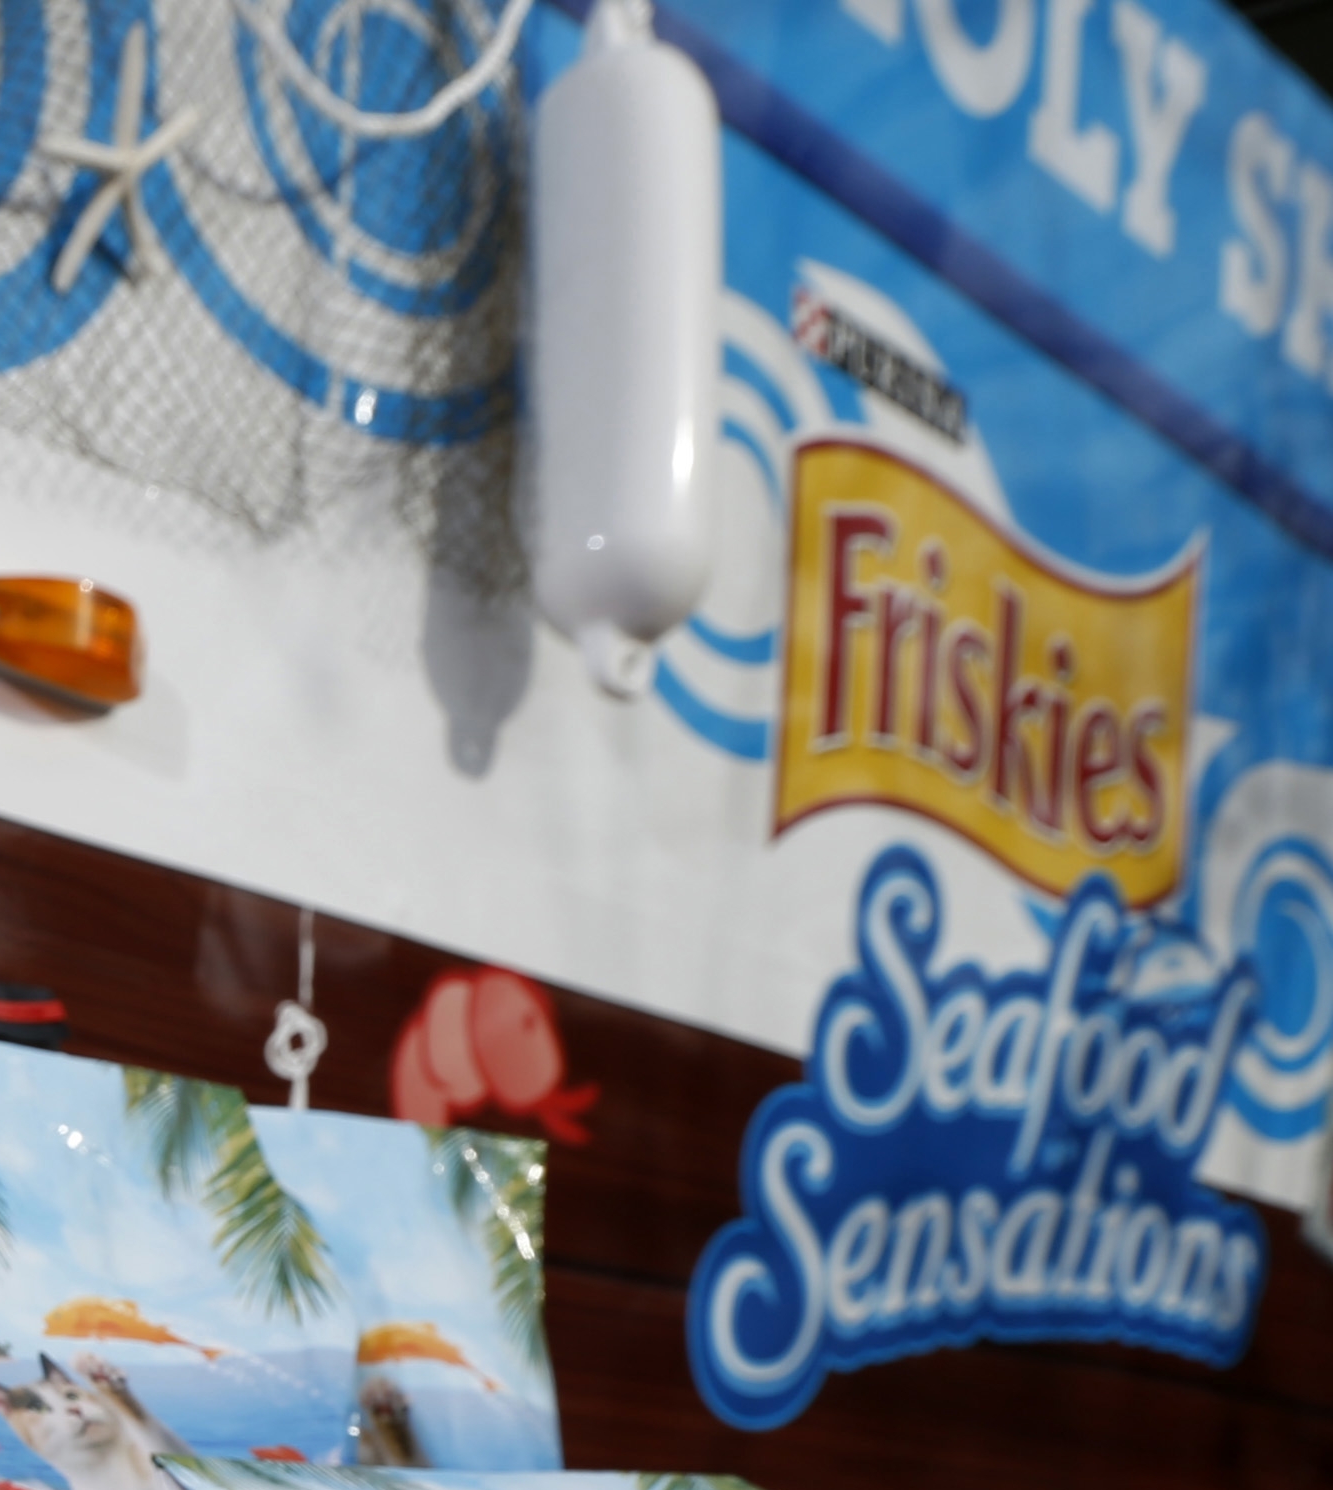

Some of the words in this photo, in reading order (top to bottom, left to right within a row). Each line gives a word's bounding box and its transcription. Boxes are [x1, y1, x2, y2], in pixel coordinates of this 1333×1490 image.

[838, 0, 1206, 258] OLY
[811, 500, 1173, 858] Friskies
[821, 872, 1258, 1180] Seafood
[710, 1120, 1258, 1385] Sensations
